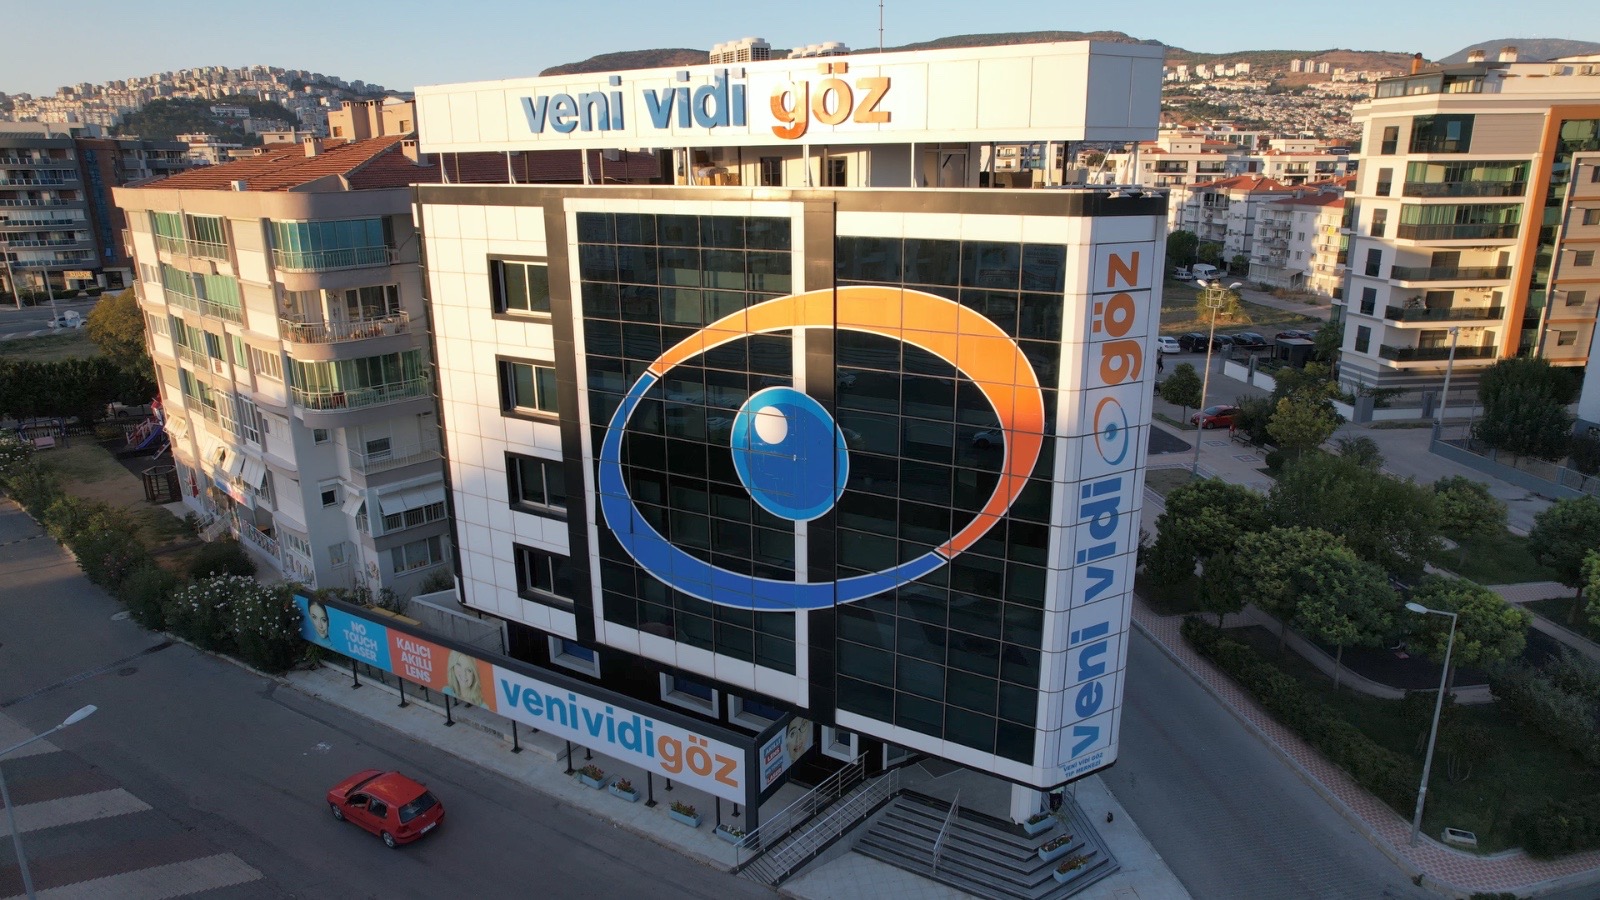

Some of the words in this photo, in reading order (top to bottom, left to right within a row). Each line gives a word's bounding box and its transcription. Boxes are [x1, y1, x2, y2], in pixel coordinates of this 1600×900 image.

[520, 75, 625, 134] veni
[643, 67, 747, 130] vidi
[769, 62, 892, 140] göz
[1092, 251, 1143, 385] göz
[1077, 477, 1122, 603] vidi
[351, 621, 367, 636] NO
[343, 629, 378, 651] TOUCH
[396, 636, 431, 659] KALICI
[348, 641, 377, 662] LASER
[401, 651, 432, 672] AKILLI
[405, 664, 431, 682] LENS
[1070, 620, 1109, 758] veni
